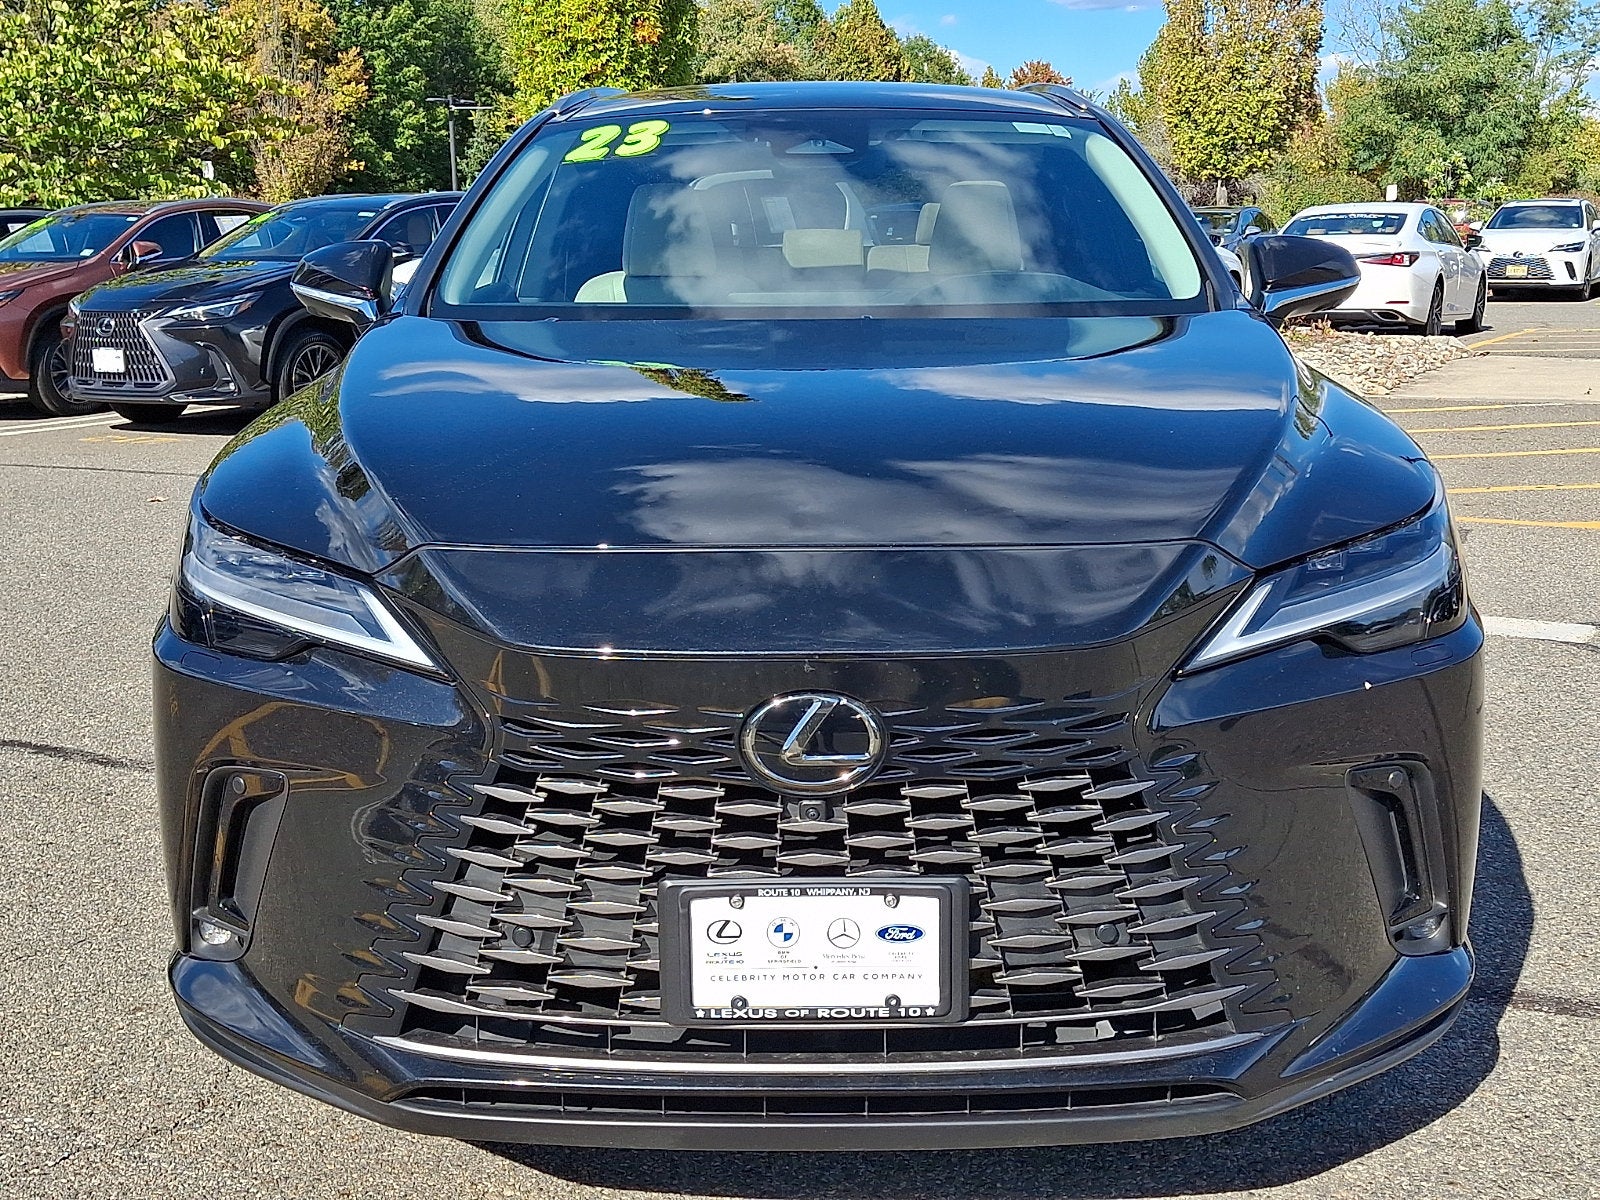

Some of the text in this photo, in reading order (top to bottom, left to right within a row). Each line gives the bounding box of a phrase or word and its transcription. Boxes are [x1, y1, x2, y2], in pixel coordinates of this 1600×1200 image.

[560, 120, 670, 164] 23
[757, 888, 801, 897] ROUTE 10
[806, 887, 871, 896] WHIPPANY, NJ
[885, 926, 916, 940] Ford
[710, 974, 776, 982] CELEBRITY
[782, 973, 825, 981] MOTOR
[832, 973, 855, 981] CAR
[710, 1007, 921, 1019] LEXUS OF ROUTE 10
